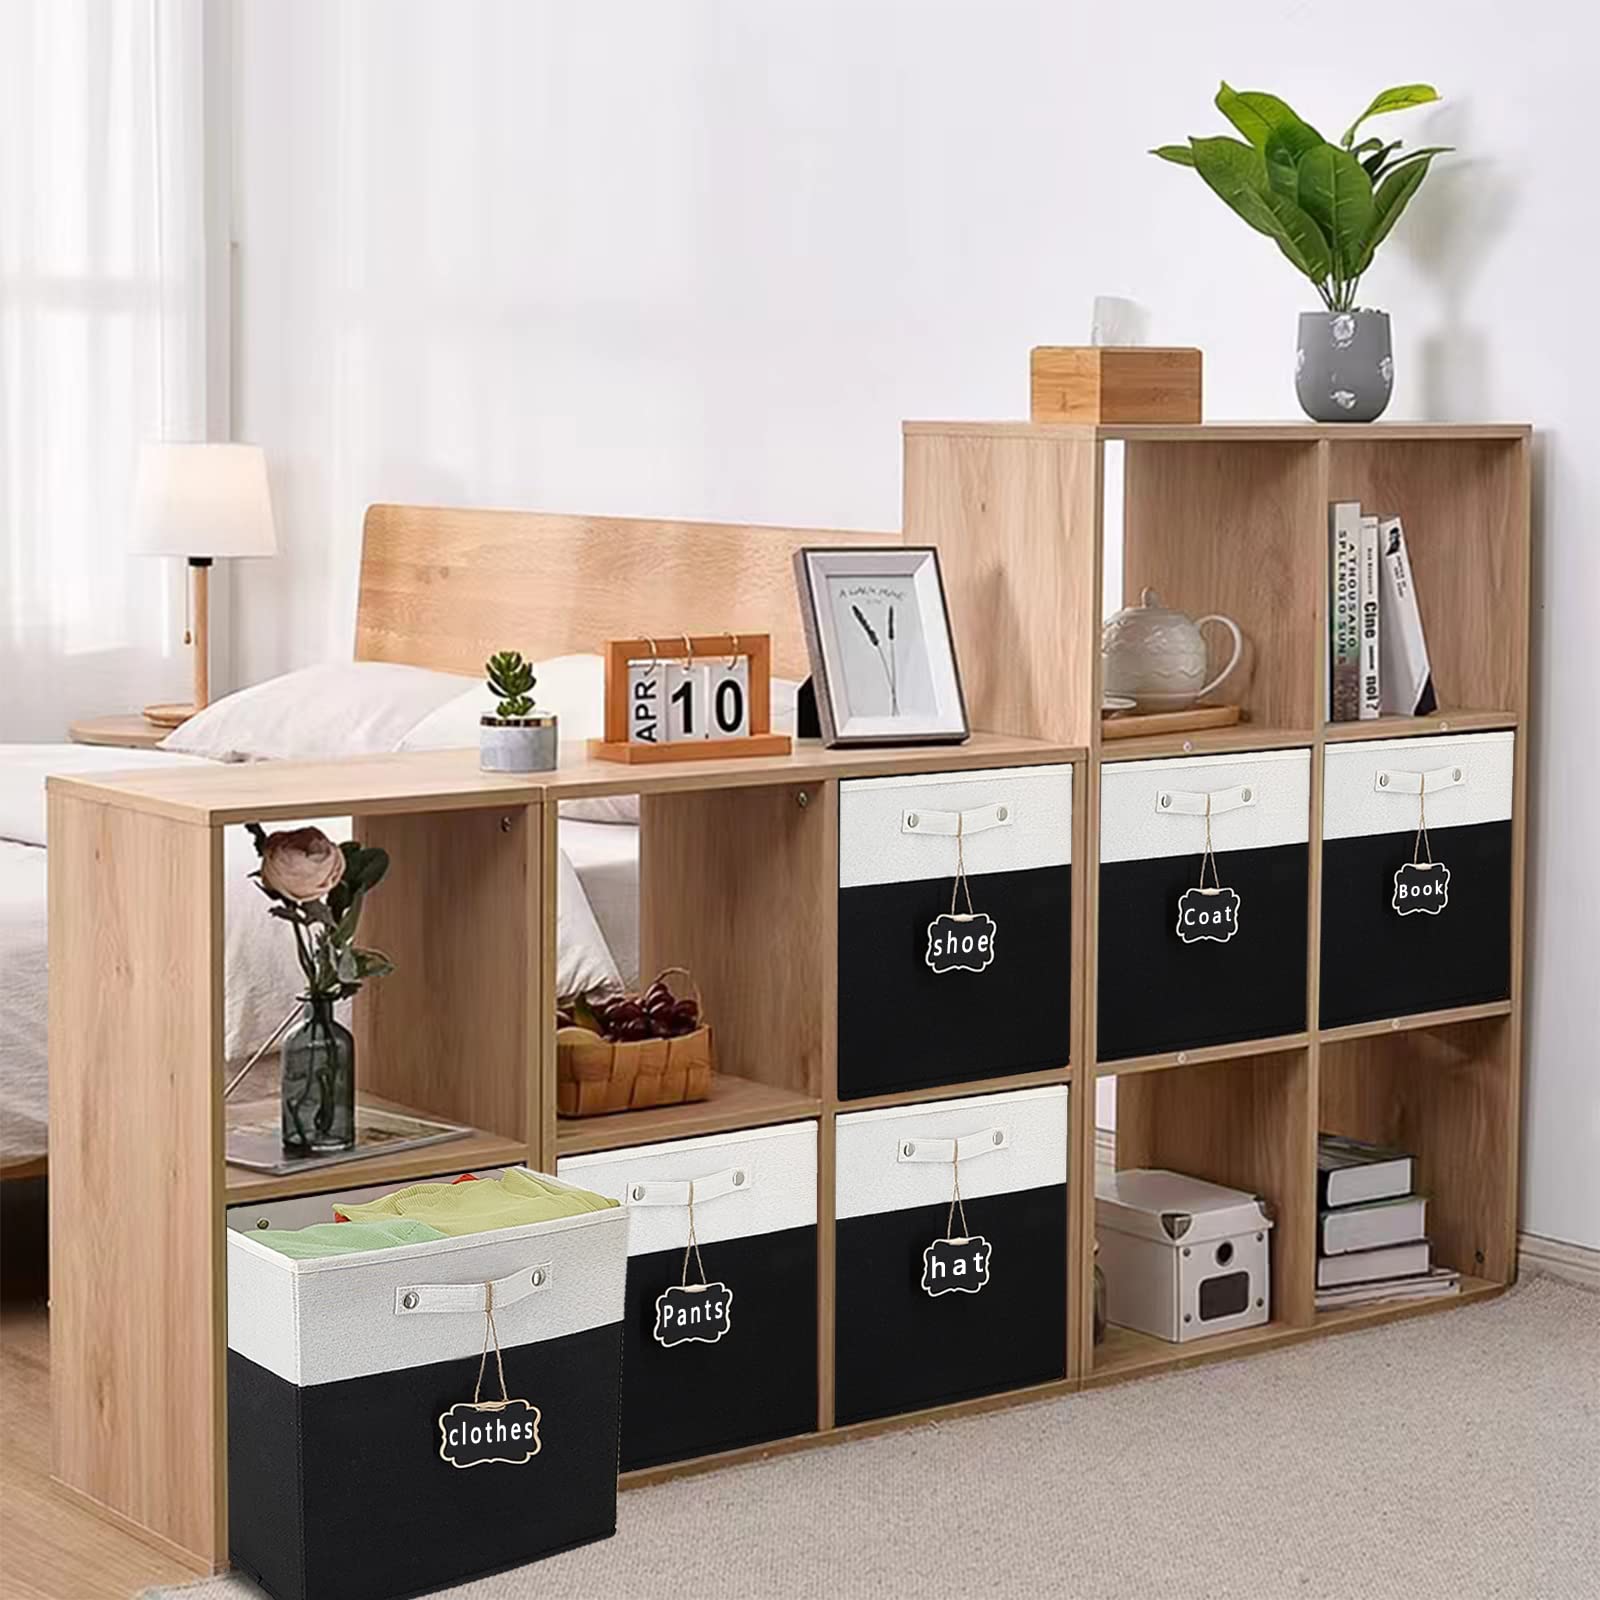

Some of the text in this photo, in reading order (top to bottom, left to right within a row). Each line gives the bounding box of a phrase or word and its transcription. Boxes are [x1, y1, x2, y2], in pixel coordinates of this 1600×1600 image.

[635, 680, 657, 744] APR
[1399, 879, 1445, 900] Book
[1184, 905, 1233, 926] Coat
[933, 930, 990, 958] shoe
[931, 1252, 985, 1280] hat
[663, 1299, 725, 1330] Pants
[448, 1418, 534, 1447] clothes
